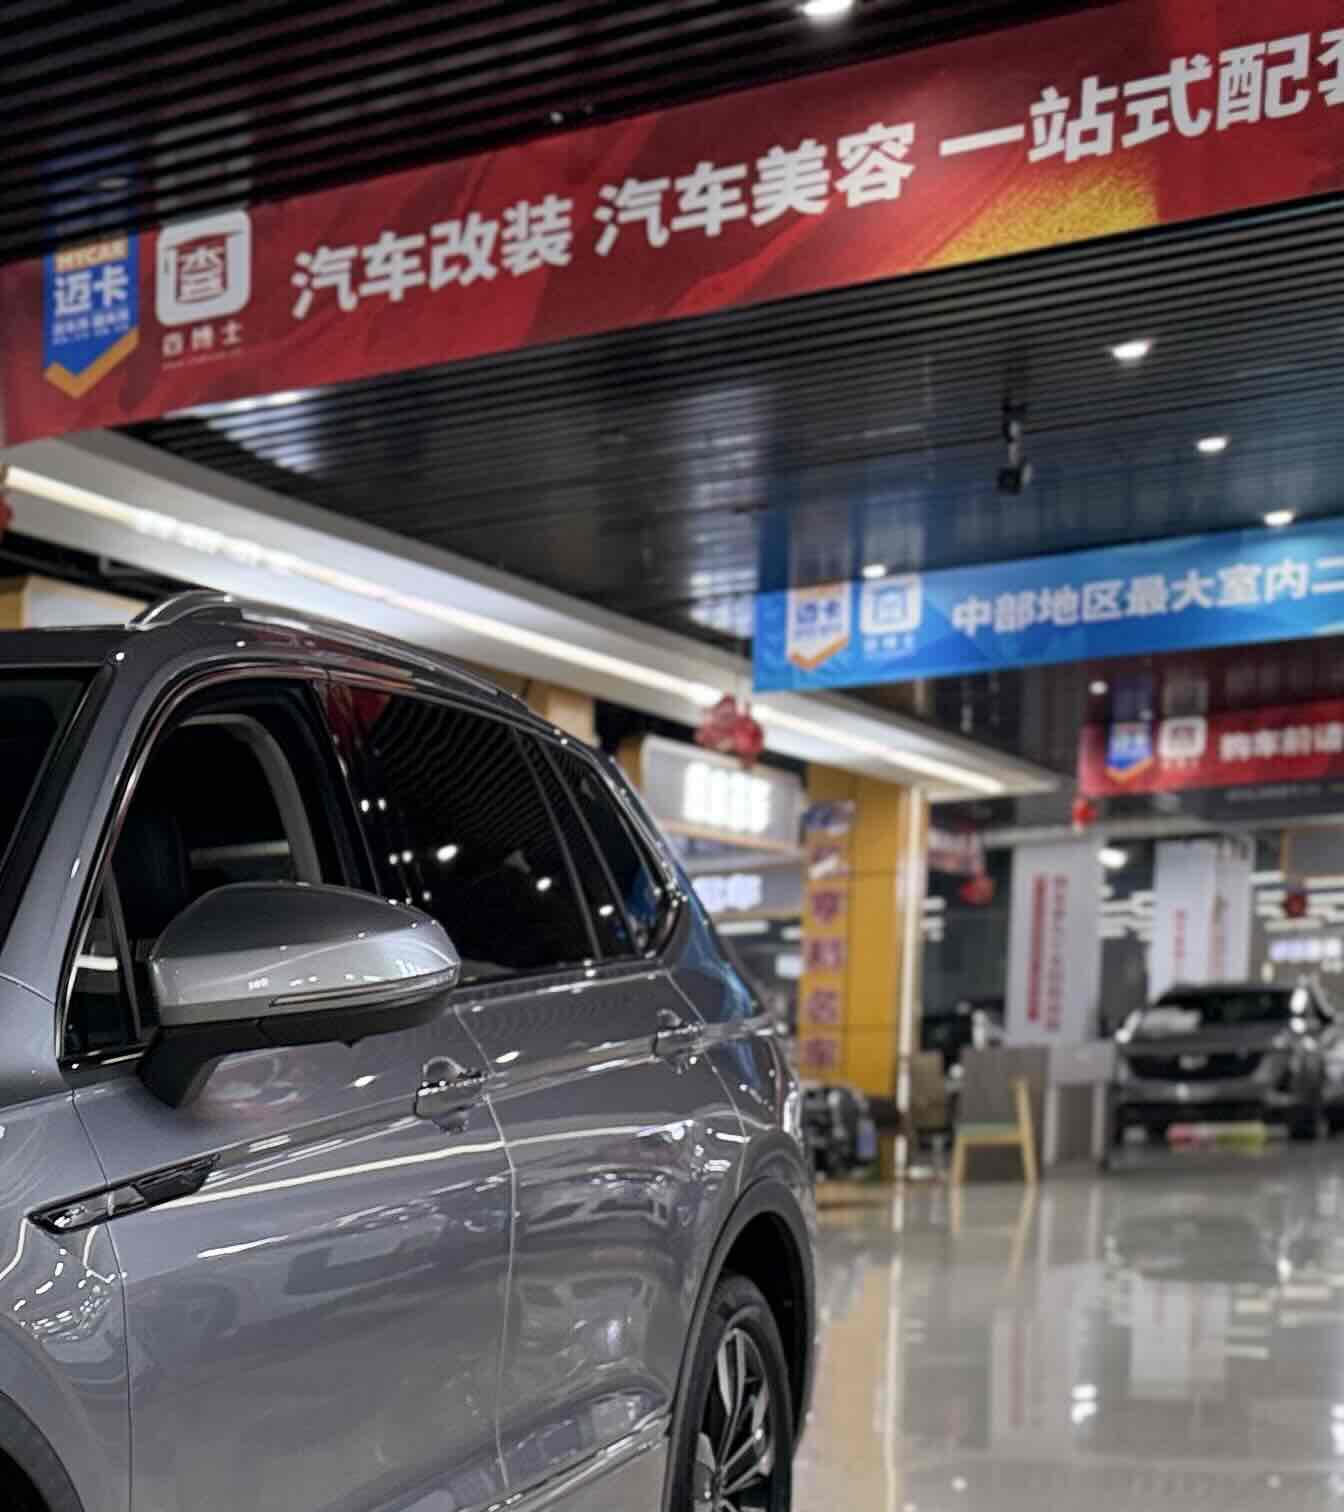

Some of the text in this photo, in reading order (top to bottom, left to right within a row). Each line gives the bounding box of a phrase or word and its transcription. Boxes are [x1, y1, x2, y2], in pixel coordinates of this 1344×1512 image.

[291, 194, 574, 320] 汽车改装
[593, 120, 916, 257] 汽车美容
[52, 264, 130, 318] 迈卡
